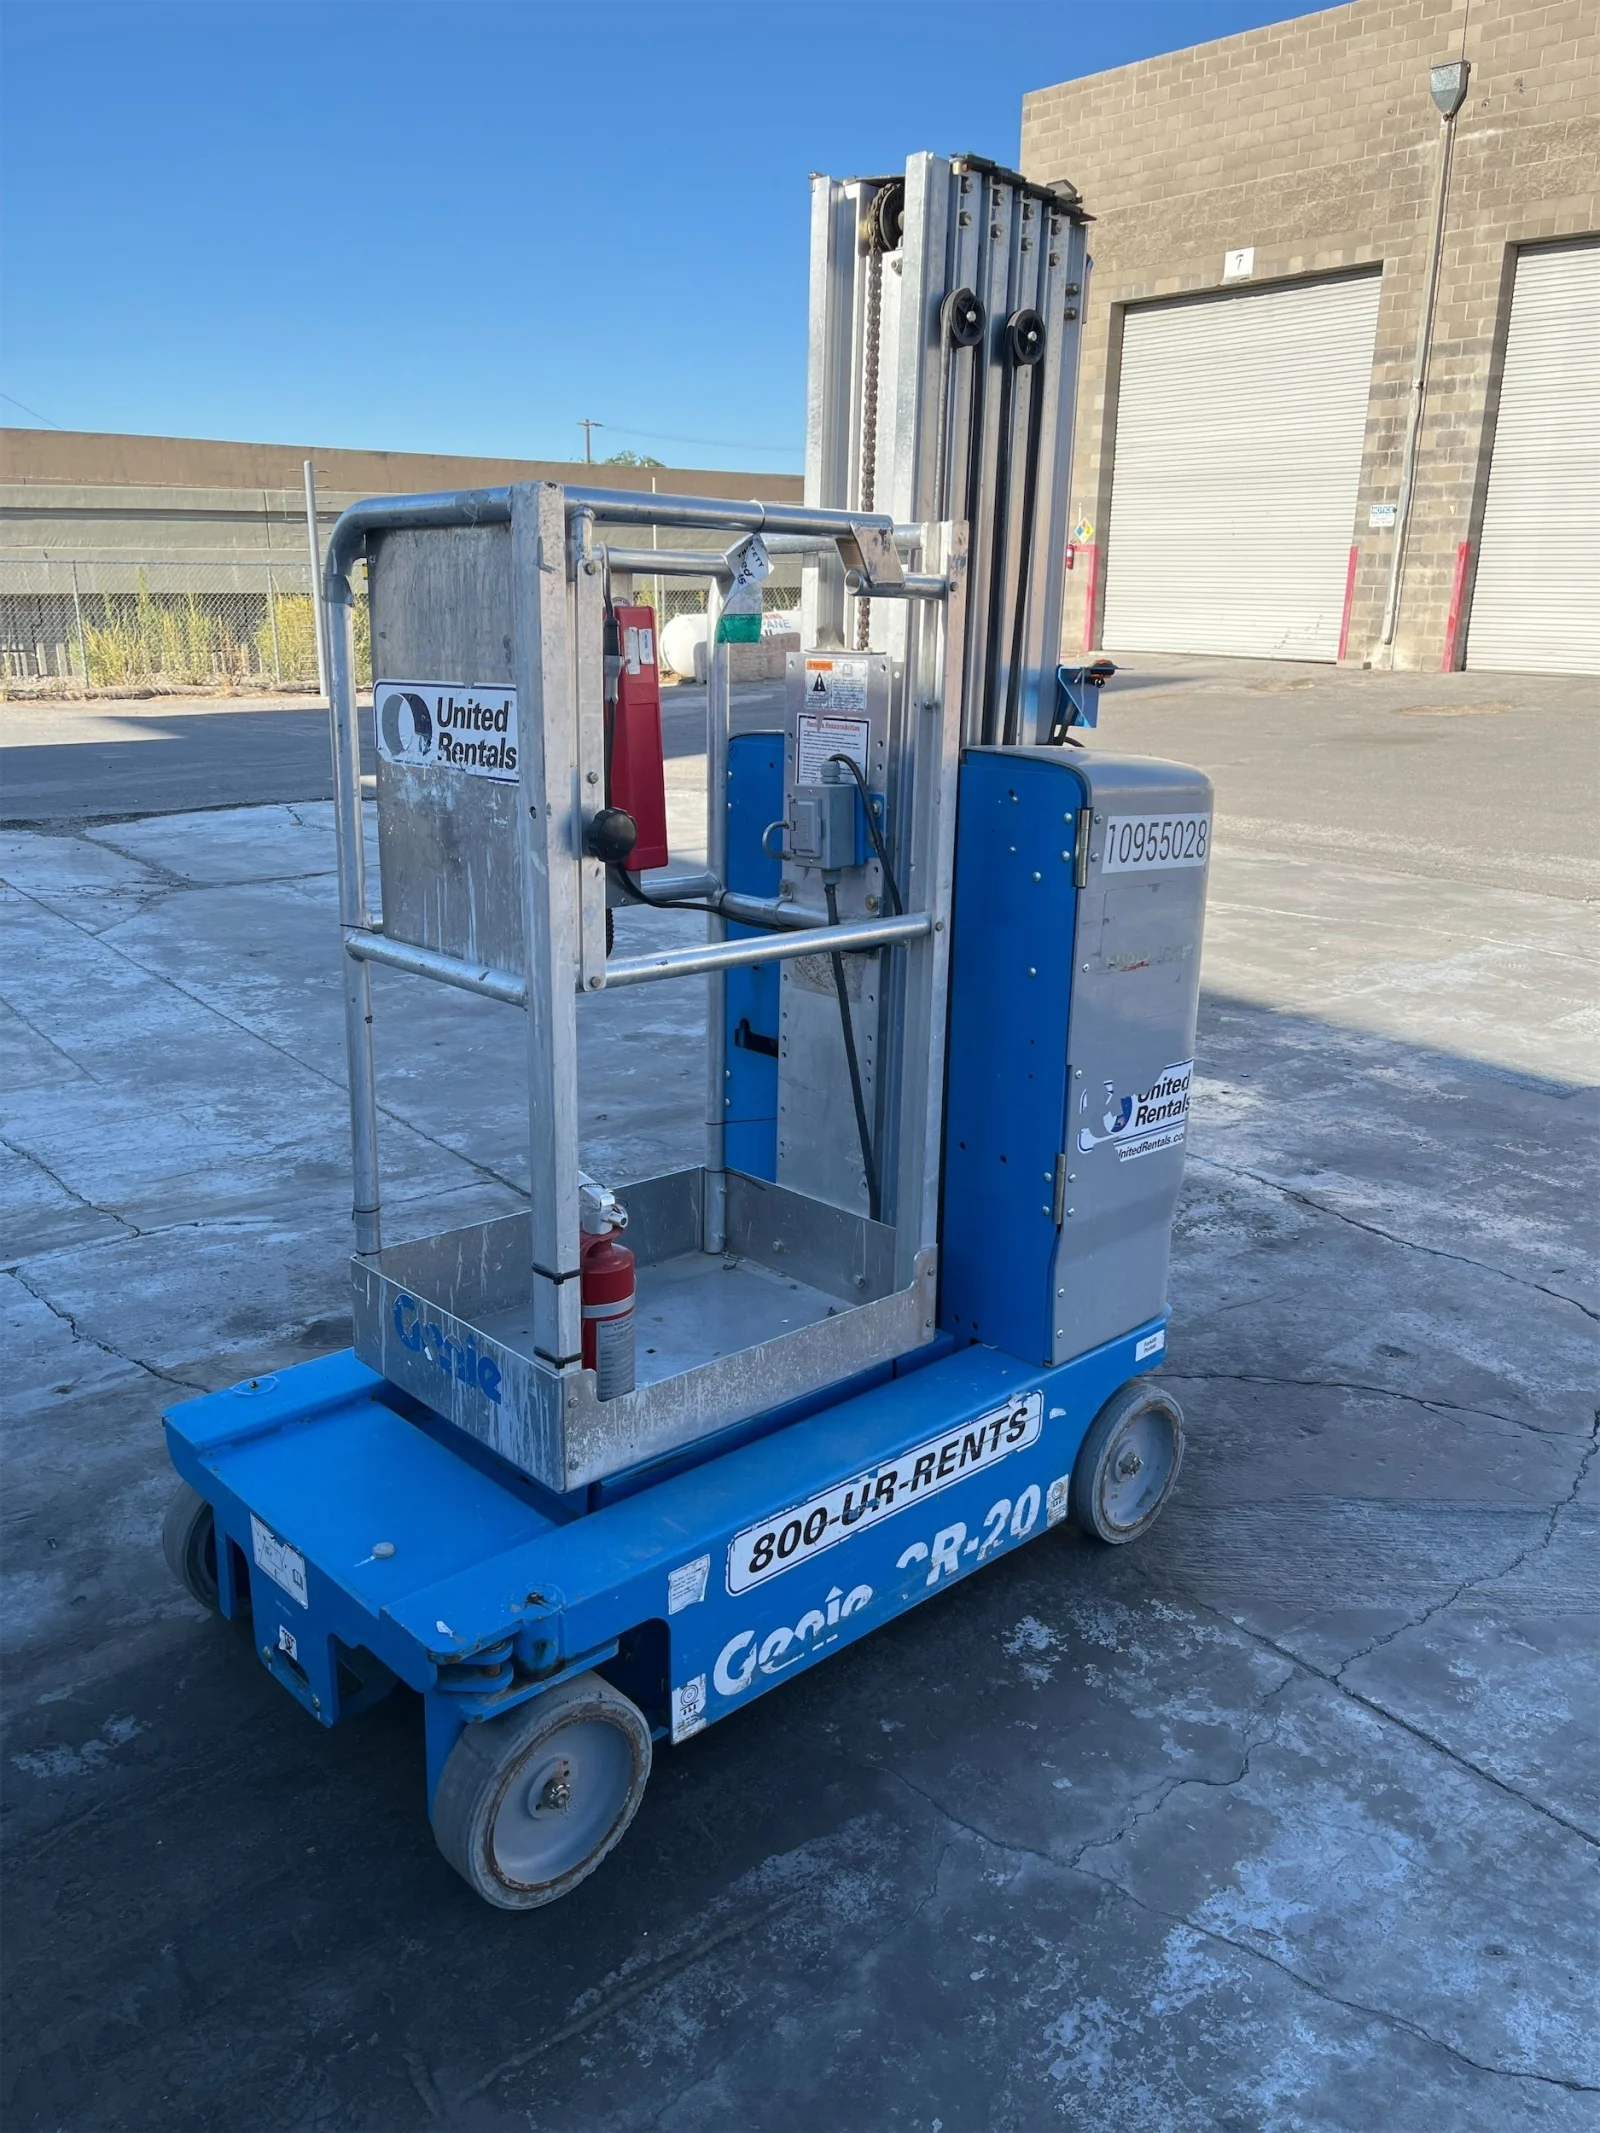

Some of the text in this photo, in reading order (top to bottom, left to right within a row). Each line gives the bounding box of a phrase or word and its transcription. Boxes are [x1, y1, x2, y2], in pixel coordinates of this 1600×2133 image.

[1235, 253, 1244, 271] 7
[437, 697, 510, 732] United
[437, 732, 517, 770] Rentals
[1108, 820, 1207, 864] 10955028
[1135, 1093, 1190, 1127] Rentals
[1118, 1133, 1184, 1159] nitedRentals.co
[748, 1407, 1028, 1574] 800-UR-RENTS
